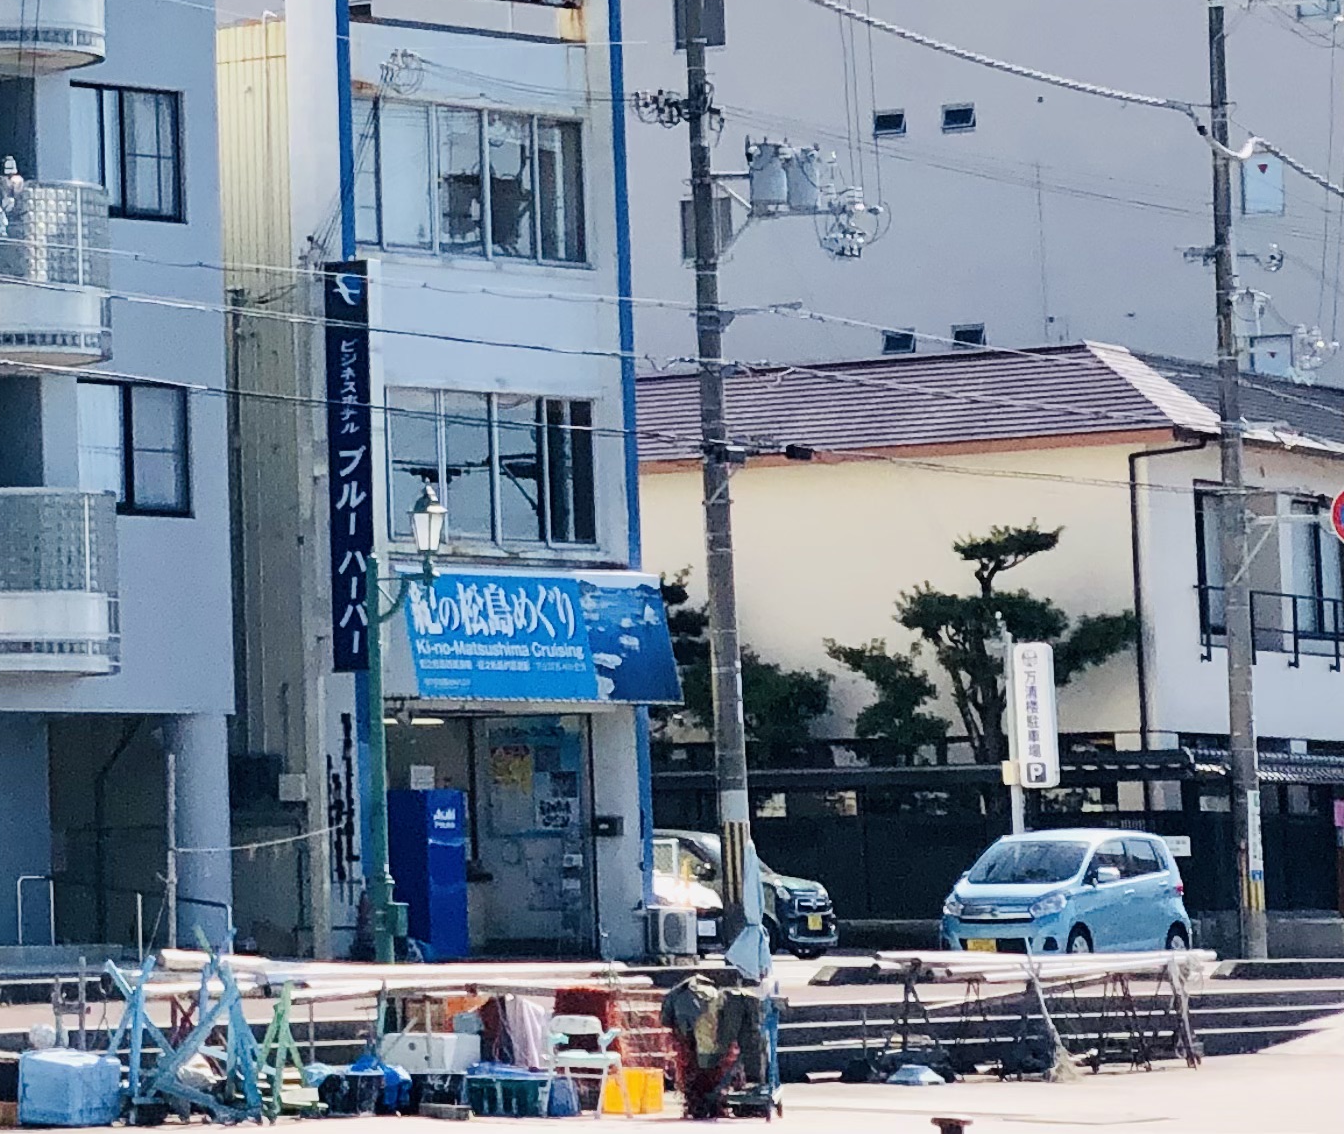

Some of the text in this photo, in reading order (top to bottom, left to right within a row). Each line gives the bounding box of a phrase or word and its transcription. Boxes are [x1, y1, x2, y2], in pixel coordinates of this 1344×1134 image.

[335, 338, 368, 654] ビジネスホテル ブルーハーバー
[409, 580, 575, 640] 紀の松島めぐり
[416, 640, 585, 660] Ki-no-Matsushima Cruising
[1029, 763, 1043, 782] P
